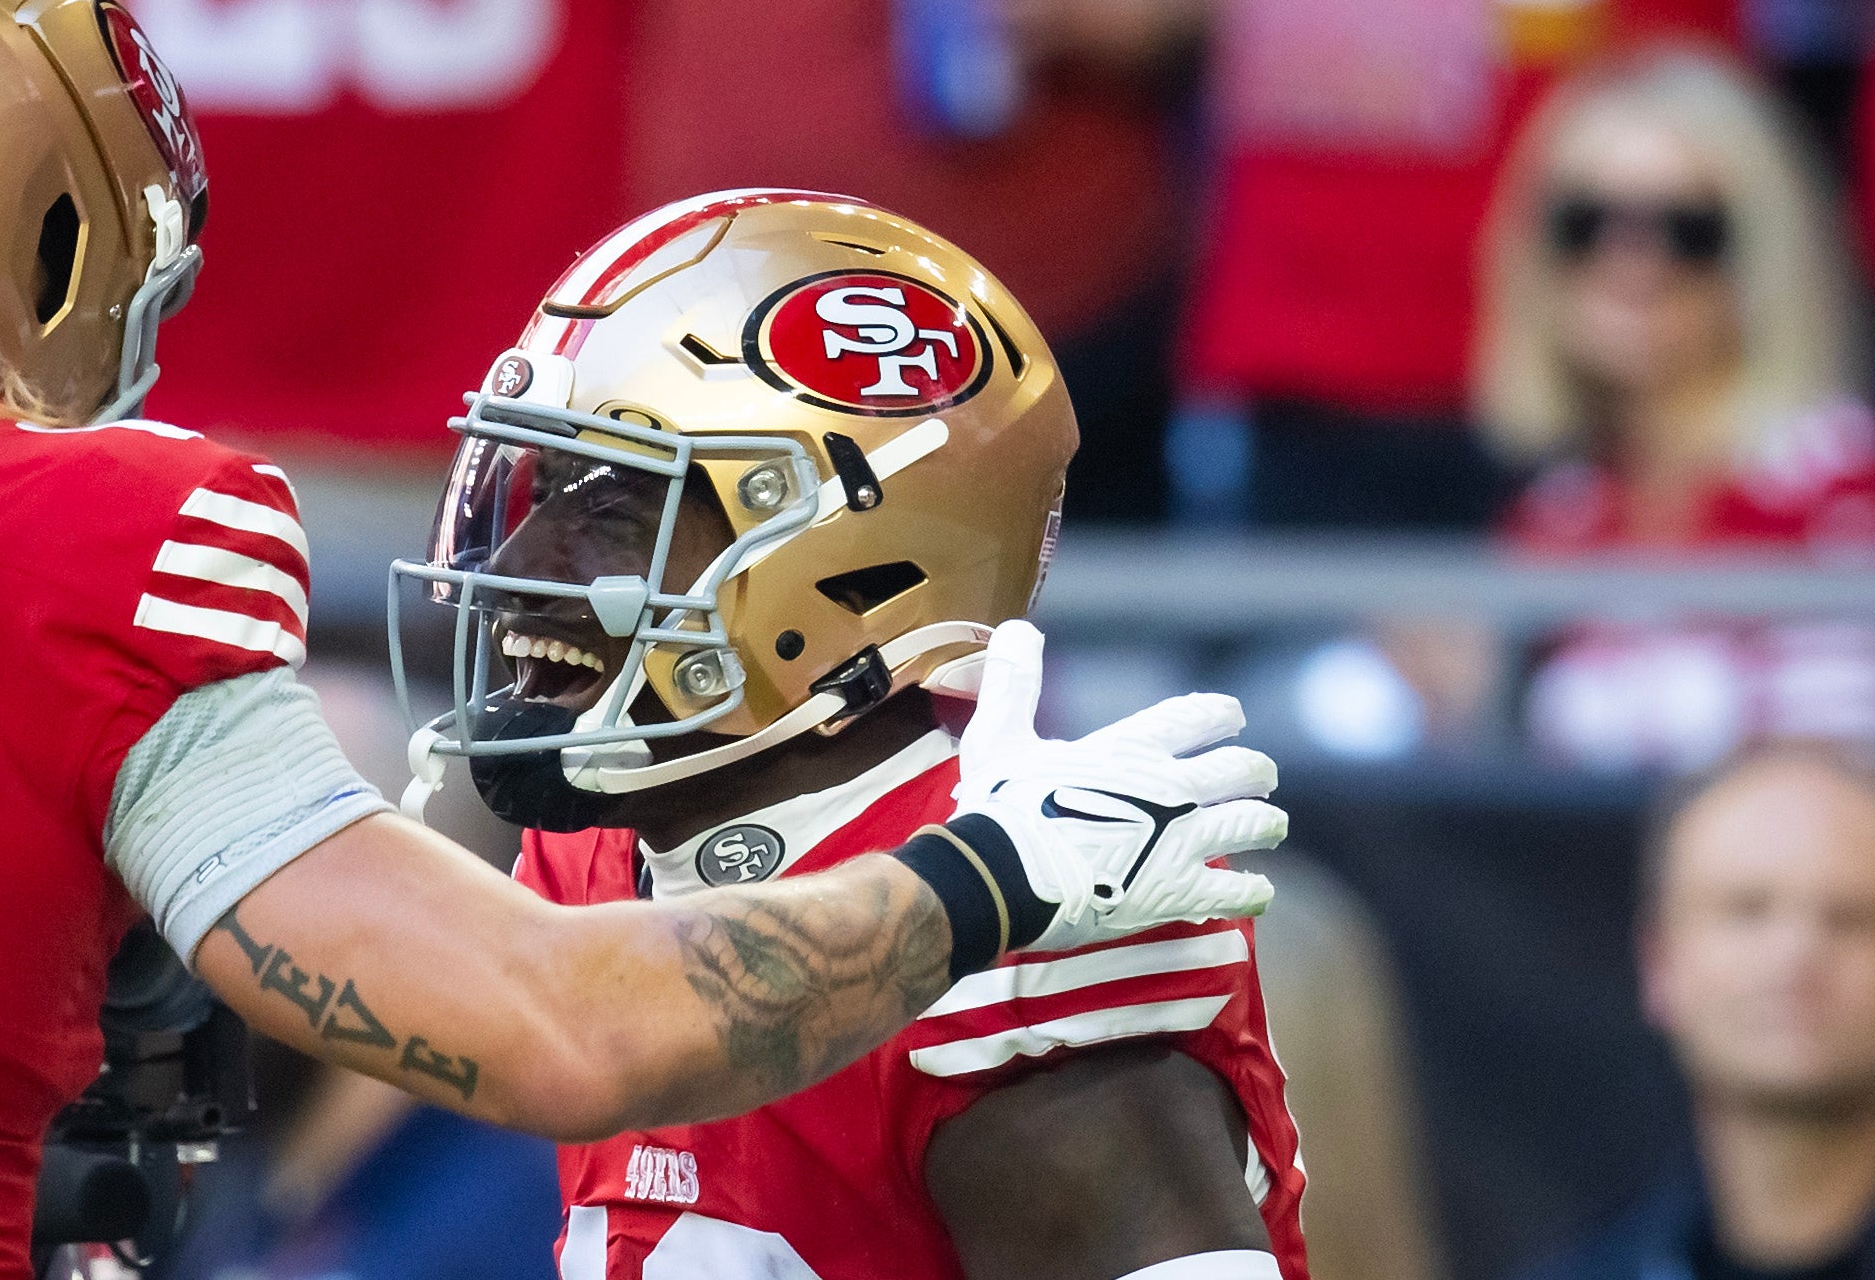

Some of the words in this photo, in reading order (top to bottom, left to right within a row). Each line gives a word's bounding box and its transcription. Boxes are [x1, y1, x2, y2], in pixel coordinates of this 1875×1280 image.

[815, 286, 959, 398] SF
[713, 832, 769, 883] SF
[624, 1144, 700, 1204] 49ERS
